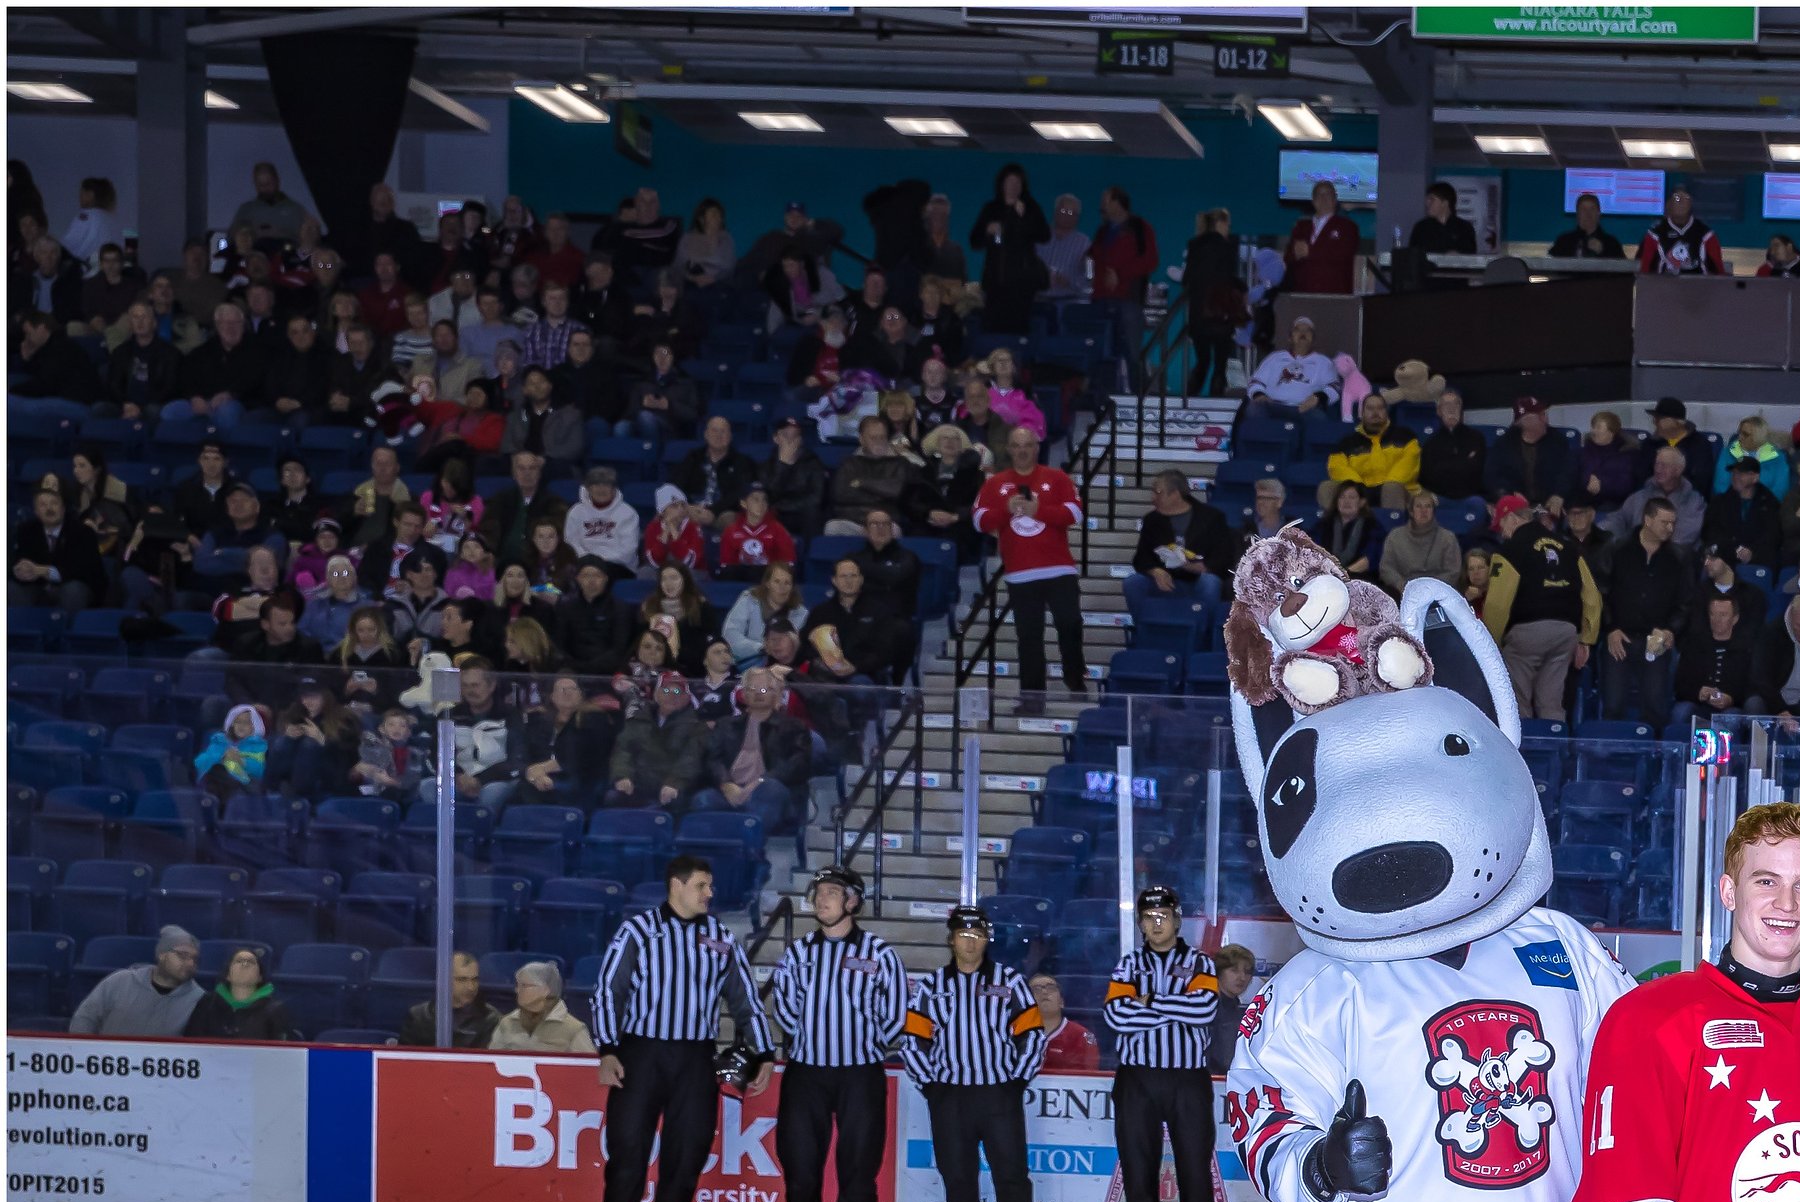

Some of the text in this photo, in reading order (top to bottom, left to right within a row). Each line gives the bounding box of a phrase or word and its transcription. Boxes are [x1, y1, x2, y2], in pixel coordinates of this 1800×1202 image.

[1493, 18, 1678, 35] www.nfcourtyard.com
[1120, 44, 1169, 67] 11-18
[1217, 47, 1268, 70] 01-12
[1445, 1012, 1519, 1031] 10 YEARS
[7, 1052, 201, 1079] 1-800-668-6868
[493, 1087, 781, 1177] Brk
[1460, 1161, 1501, 1176] 2007
[1513, 1150, 1542, 1173] 2017
